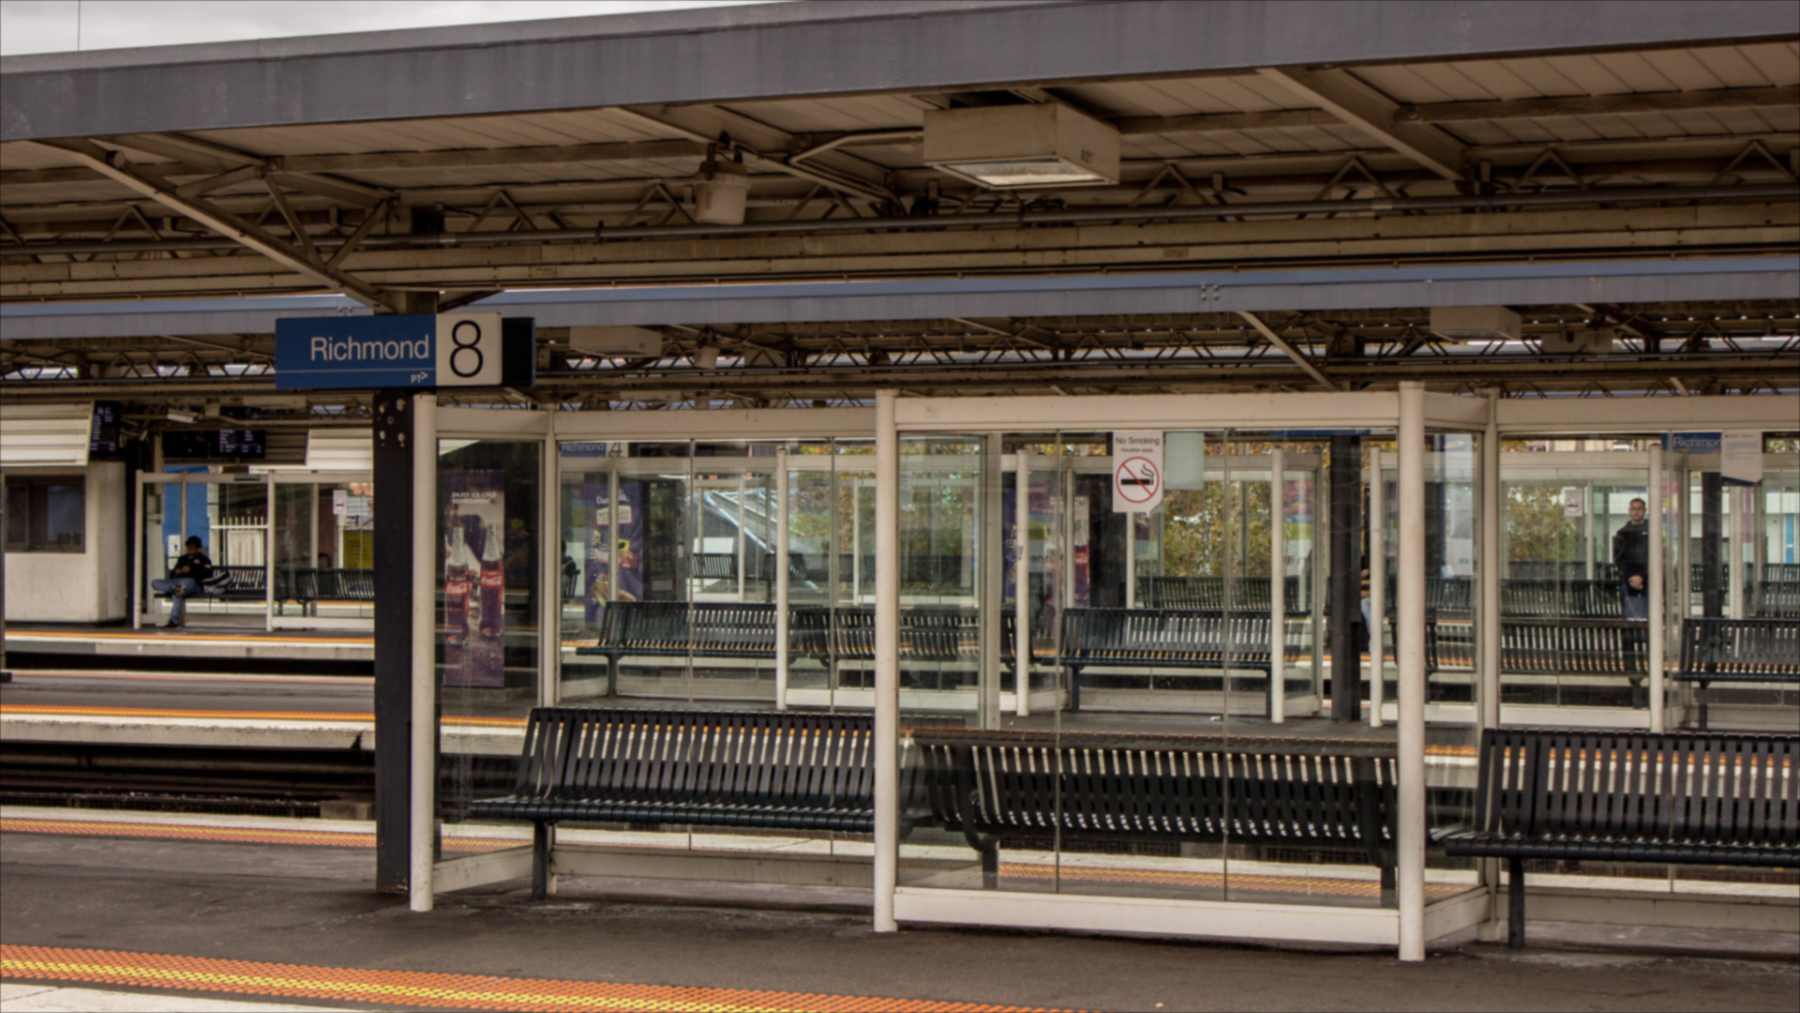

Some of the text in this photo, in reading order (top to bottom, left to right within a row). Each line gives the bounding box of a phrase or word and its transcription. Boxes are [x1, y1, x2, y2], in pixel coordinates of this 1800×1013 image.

[310, 335, 429, 361] Richmond
[450, 319, 483, 378] 8
[1115, 436, 1160, 446] No Smoking
